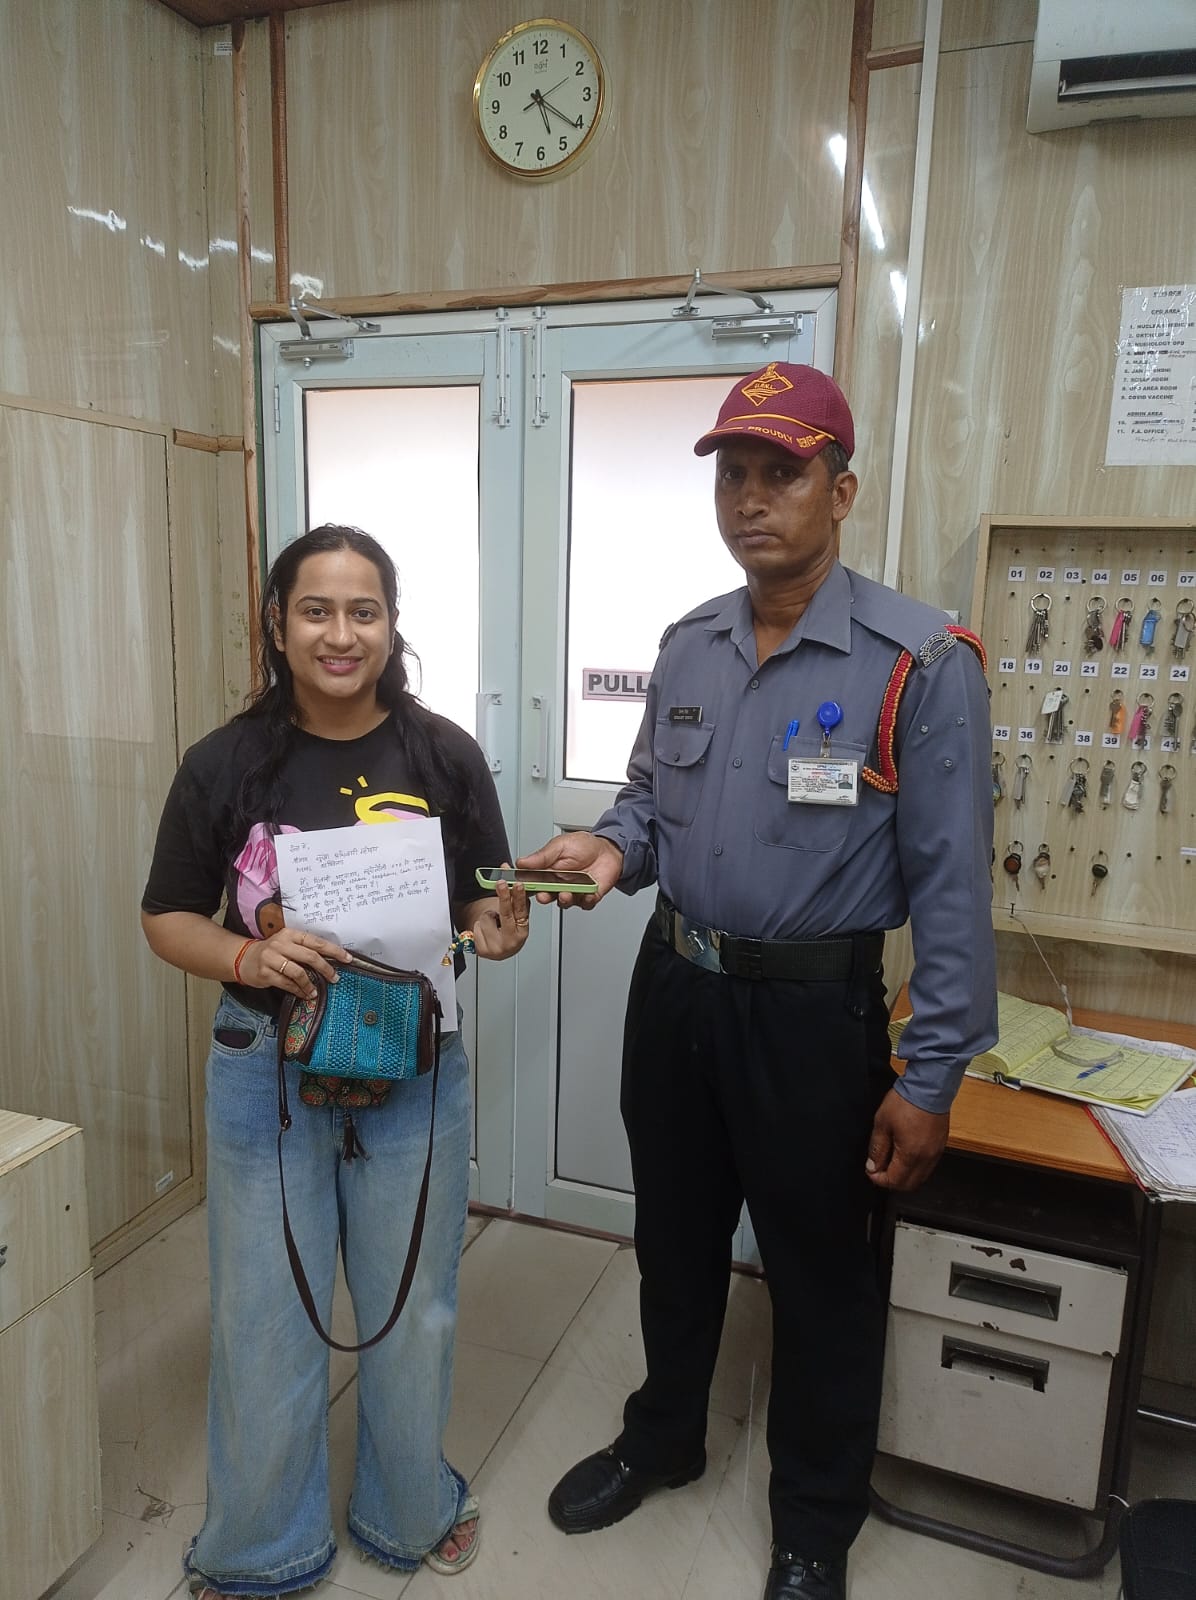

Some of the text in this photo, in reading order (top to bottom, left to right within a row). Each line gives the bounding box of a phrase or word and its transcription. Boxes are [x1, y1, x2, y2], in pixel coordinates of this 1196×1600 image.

[533, 40, 548, 54] 12
[560, 44, 566, 58] 1
[513, 51, 524, 65] 11
[576, 62, 584, 76] 2
[497, 72, 511, 87] 10
[583, 87, 591, 101] 3
[492, 100, 500, 114] 9
[575, 115, 584, 129] 4
[499, 125, 507, 139] 8
[515, 142, 523, 156] 7
[559, 137, 567, 150] 5
[537, 147, 545, 160] 6
[748, 426, 792, 444] PROUDLY
[1040, 571, 1052, 579] 02
[1066, 572, 1079, 580] 03
[1094, 573, 1107, 581] 04
[1151, 574, 1164, 582] 06
[1002, 662, 1014, 670] 18
[1083, 666, 1095, 674] 21
[1142, 668, 1155, 676] 23
[1173, 670, 1186, 678] 24
[589, 674, 648, 693] PULL
[996, 729, 1008, 737] 35
[1020, 731, 1032, 739] 36
[1078, 734, 1090, 742] 38
